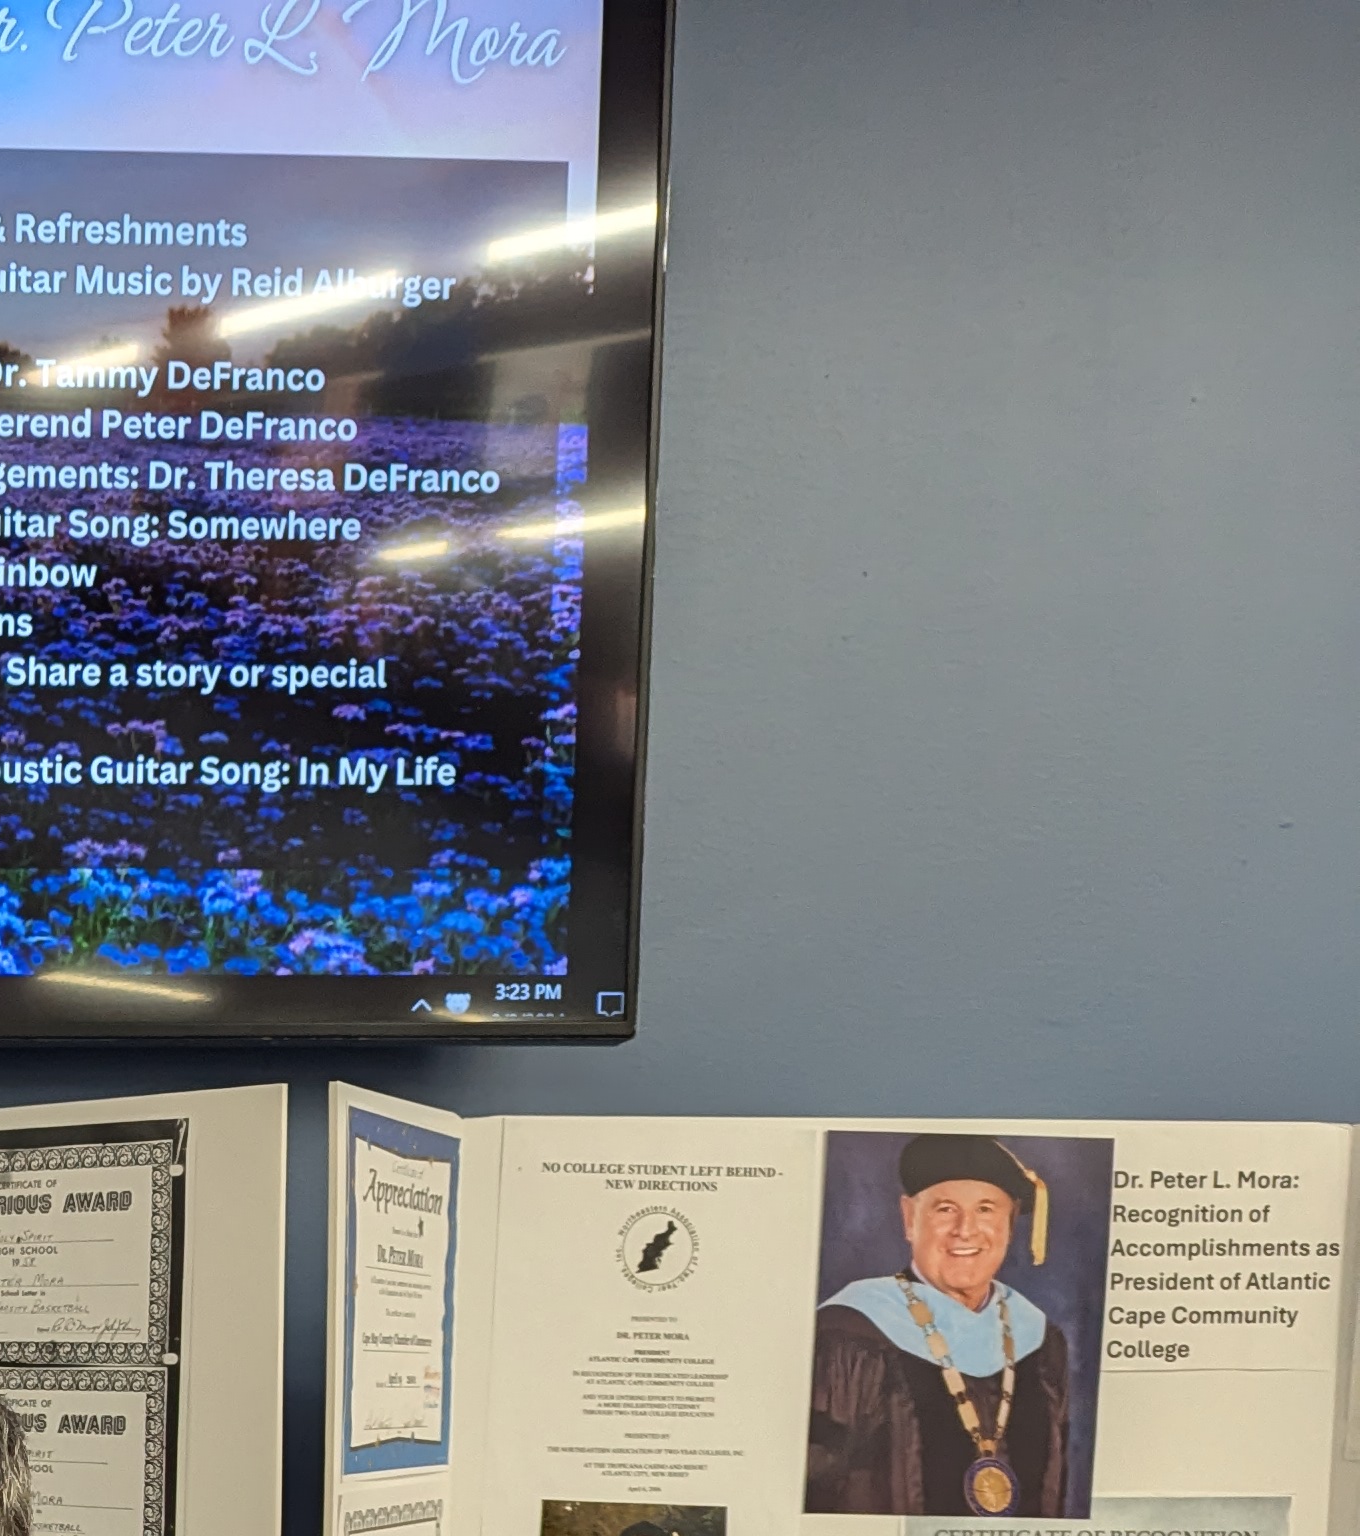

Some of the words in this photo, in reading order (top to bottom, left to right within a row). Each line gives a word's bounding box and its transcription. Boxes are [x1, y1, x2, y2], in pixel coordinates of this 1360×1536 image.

[47, 0, 237, 62] Peter
[243, 0, 320, 76] L.
[343, 0, 568, 86] Mora
[15, 212, 248, 247] Refreshments
[75, 265, 173, 296] Music
[181, 265, 223, 304] by
[232, 267, 303, 298] Reid
[311, 269, 457, 308] Alburger
[36, 358, 160, 397] Tammy
[167, 360, 326, 392] DeFranco
[102, 410, 192, 441] Peter
[199, 411, 358, 443] DeFranco
[147, 460, 197, 491] Dr.
[205, 461, 336, 493] Theresa
[343, 463, 501, 495] DeFranco
[68, 511, 161, 547] Song:
[166, 510, 362, 542] Somewhere
[6, 656, 103, 688] Share
[108, 664, 130, 688] a
[136, 660, 222, 698] story
[228, 665, 266, 688] or
[270, 658, 387, 698] special
[89, 755, 194, 788] Guitar
[199, 757, 291, 795] Song:
[298, 757, 331, 786] In
[336, 757, 388, 795] My
[394, 756, 457, 787] Life
[495, 982, 530, 1000] 3:23
[535, 983, 563, 1000] PM
[541, 1162, 561, 1174] NO
[564, 1162, 626, 1175] COLLEGE
[629, 1164, 687, 1176] STUDENT
[690, 1165, 724, 1177] LEFT
[726, 1166, 777, 1178] BEHIND
[1113, 1170, 1145, 1190] Dr.
[1150, 1170, 1207, 1190] Peter
[1213, 1171, 1231, 1190] L.
[1237, 1171, 1299, 1190] Mora:
[363, 1168, 443, 1215] Appreciation
[605, 1179, 635, 1191] NEW
[638, 1179, 718, 1192] DIRECTIONS
[62, 1190, 133, 1214] AWARD
[1112, 1204, 1243, 1229] Recognition
[1248, 1203, 1271, 1224] of
[20, 1246, 58, 1256] SCHOOL
[1110, 1237, 1310, 1263] Accomplishments
[1316, 1242, 1340, 1258] as
[1109, 1272, 1213, 1291] President
[1219, 1271, 1241, 1291] of
[1246, 1272, 1331, 1291] Atlantic
[1108, 1306, 1166, 1330] Cape
[1171, 1305, 1298, 1330] Community
[1106, 1339, 1191, 1364] College
